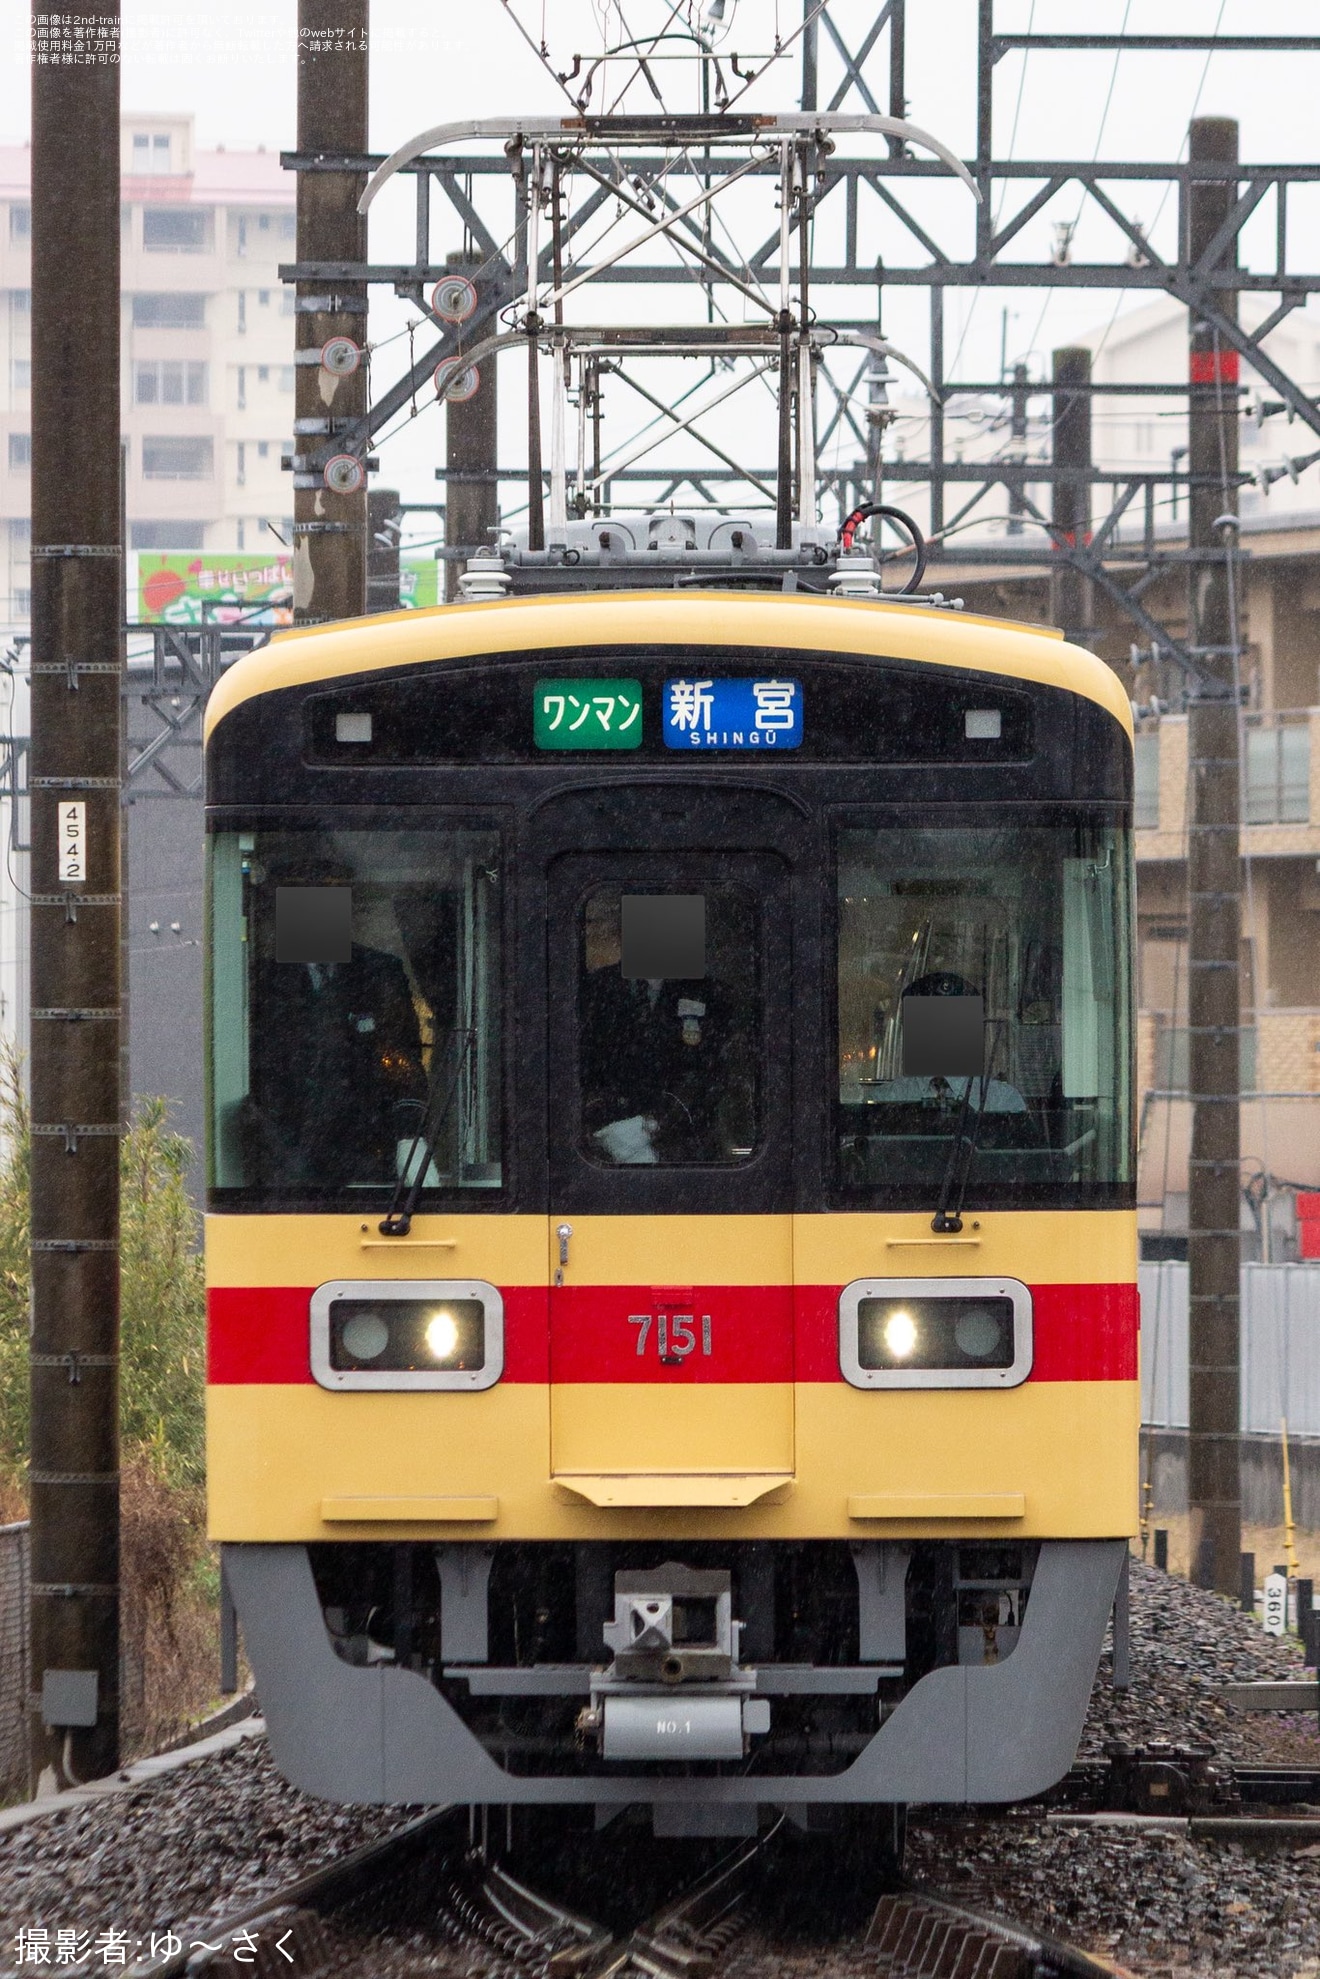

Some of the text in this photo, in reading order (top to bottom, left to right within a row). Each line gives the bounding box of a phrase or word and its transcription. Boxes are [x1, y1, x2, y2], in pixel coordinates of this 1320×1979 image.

[543, 695, 641, 731] ワンマン
[669, 679, 796, 731] 新宮
[689, 729, 777, 745] SHINGŪ
[627, 1314, 713, 1356] 7151
[1267, 1587, 1282, 1626] 360
